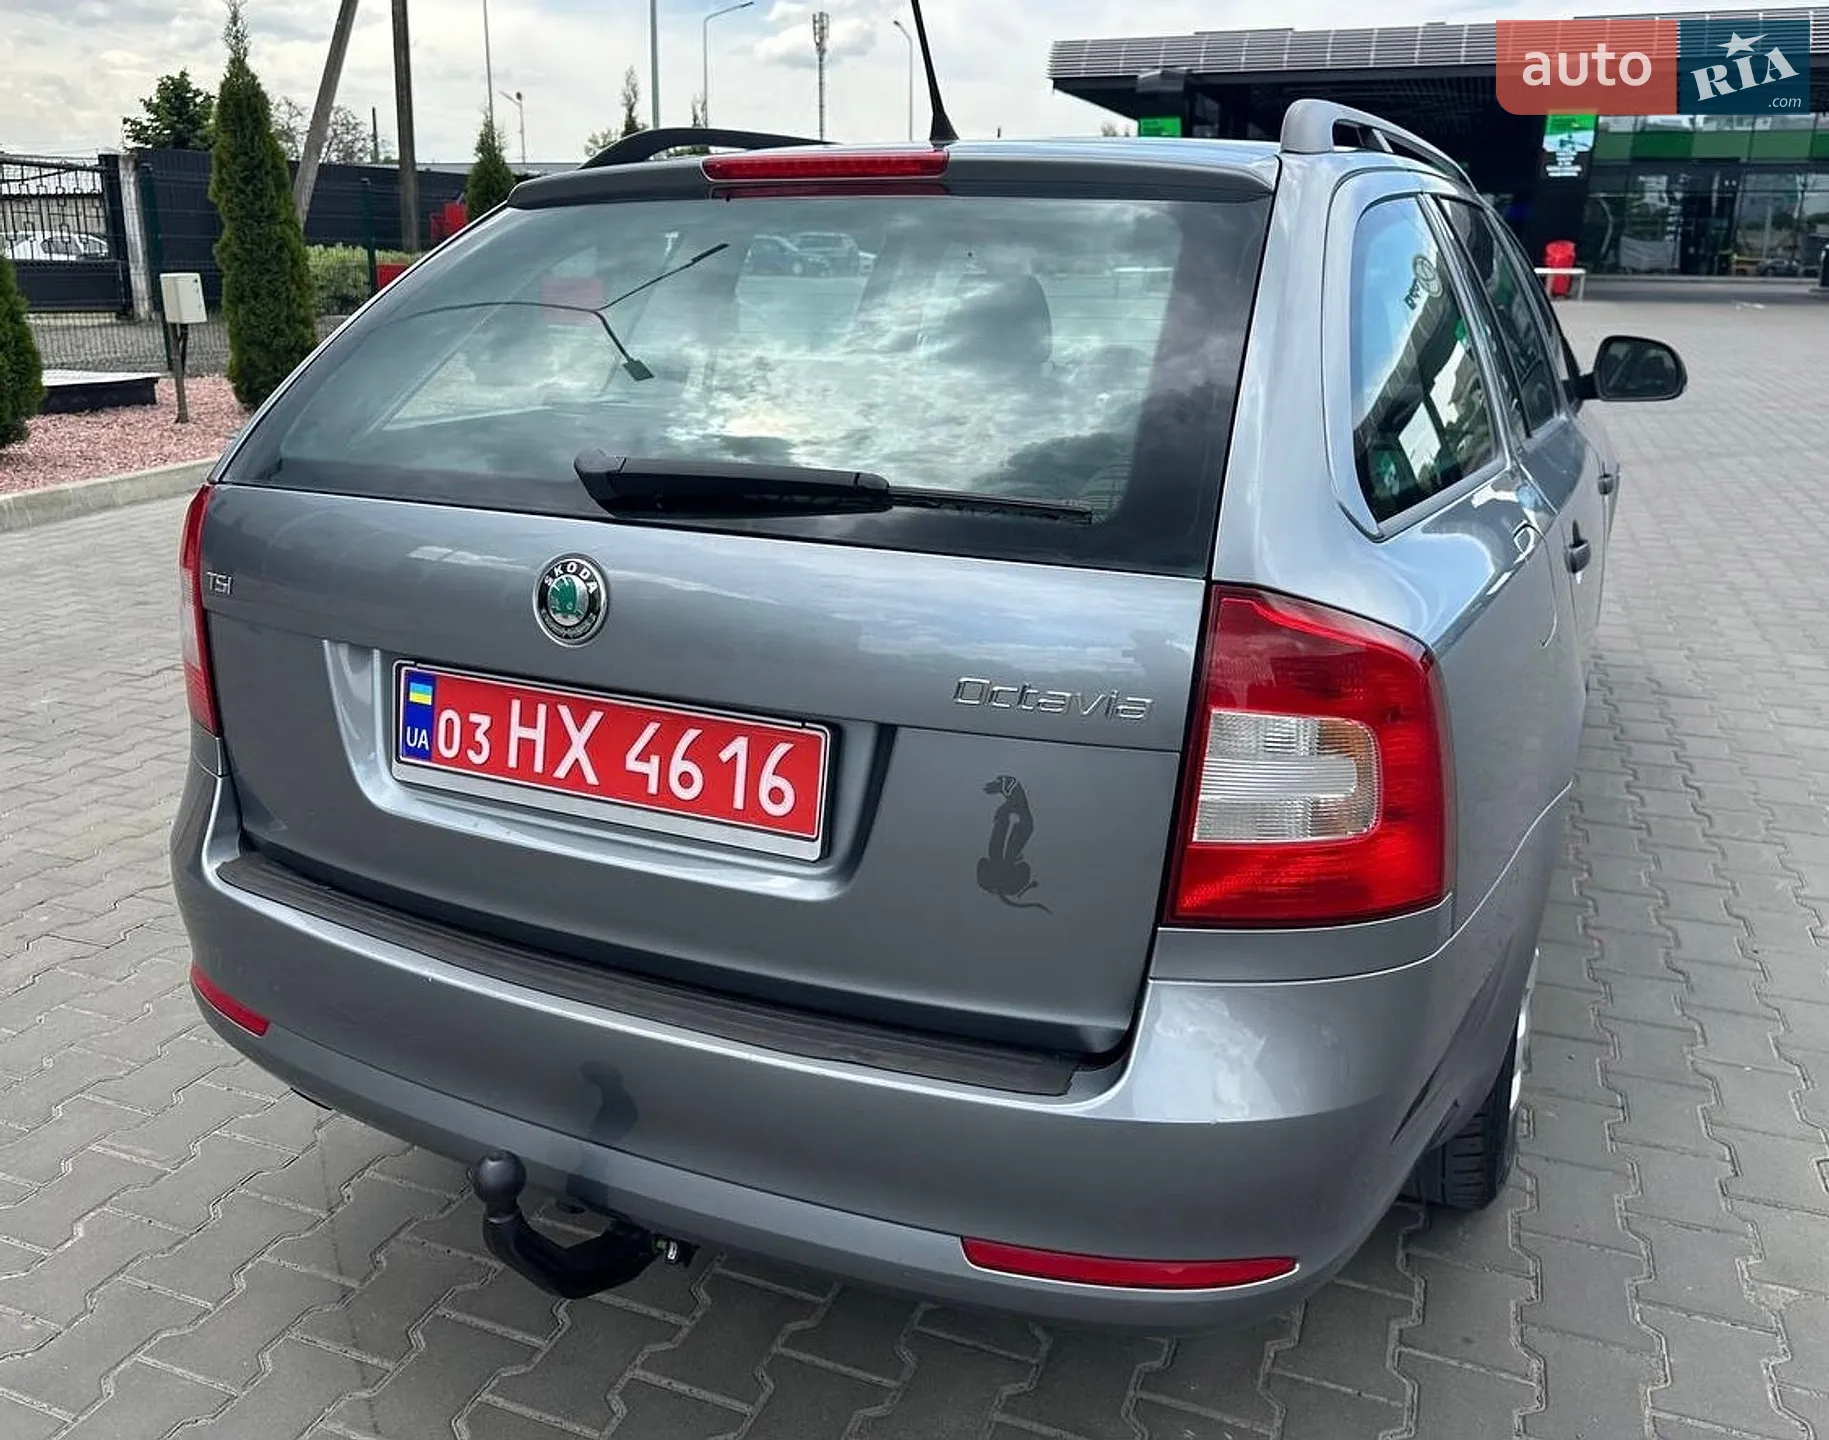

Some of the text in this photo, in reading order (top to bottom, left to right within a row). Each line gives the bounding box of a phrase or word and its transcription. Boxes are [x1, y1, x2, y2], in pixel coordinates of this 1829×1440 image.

[952, 676, 1154, 720] Octavia
[406, 726, 429, 751] UA
[436, 698, 797, 817] 03 HX 4616
